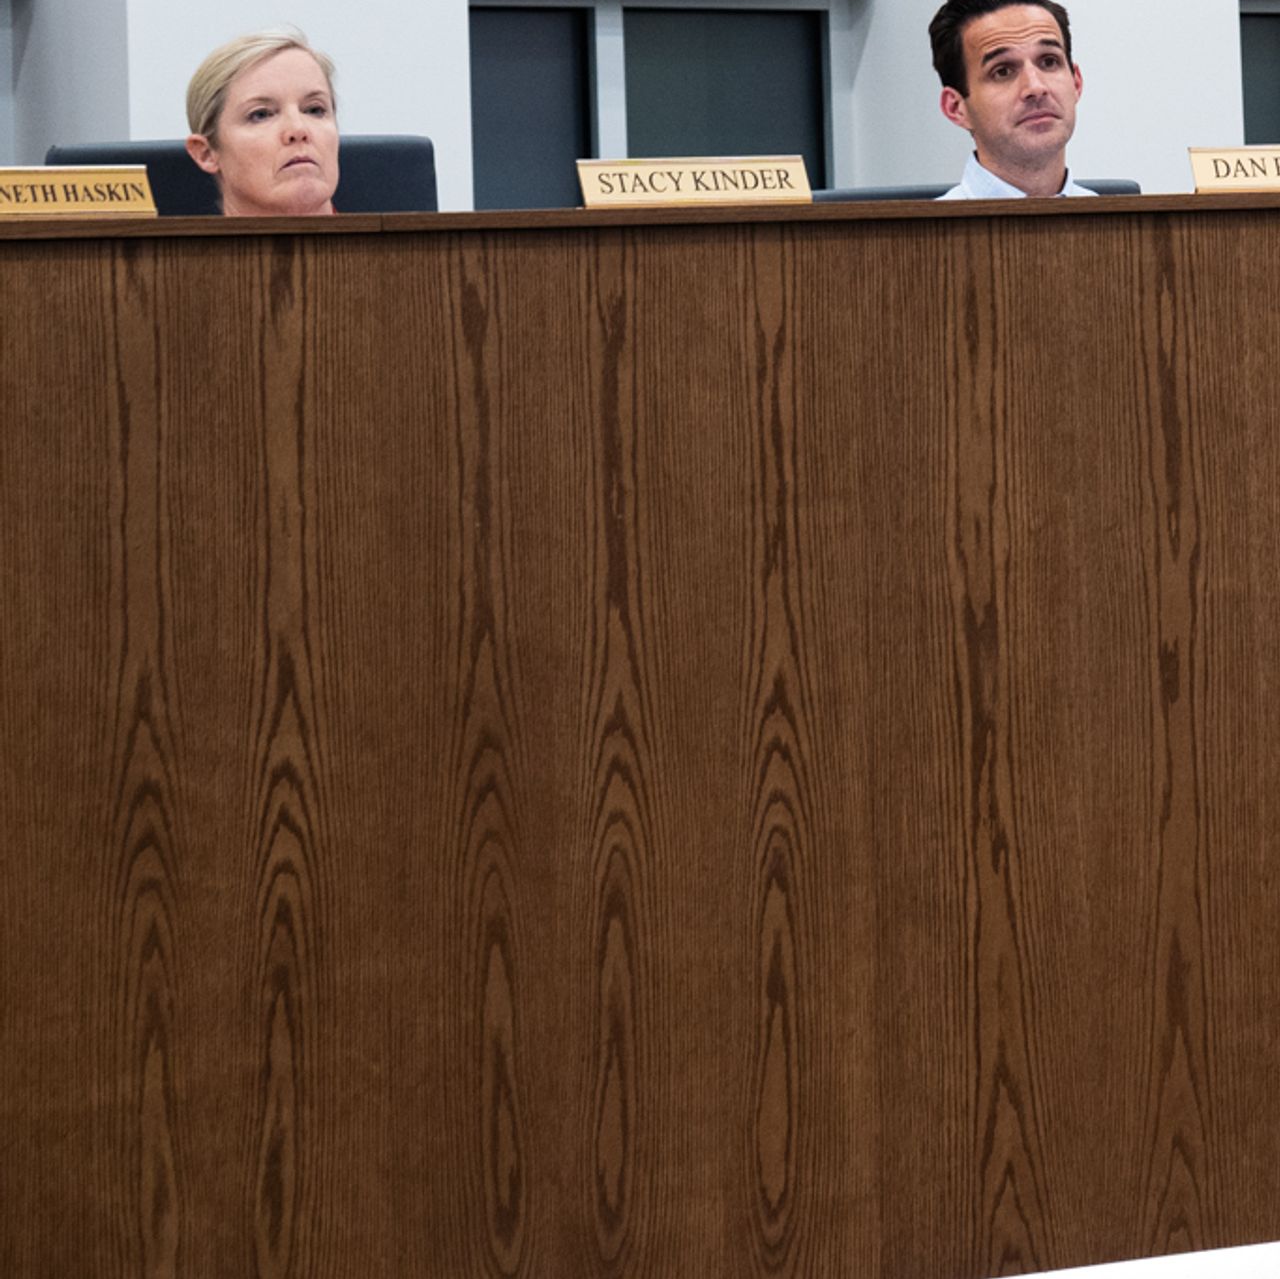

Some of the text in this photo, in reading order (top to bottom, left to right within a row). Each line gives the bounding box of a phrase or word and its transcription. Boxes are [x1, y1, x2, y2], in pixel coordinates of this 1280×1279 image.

[1212, 157, 1268, 179] DAN
[62, 182, 146, 203] HASKIN
[597, 168, 796, 195] STACY KINDER
